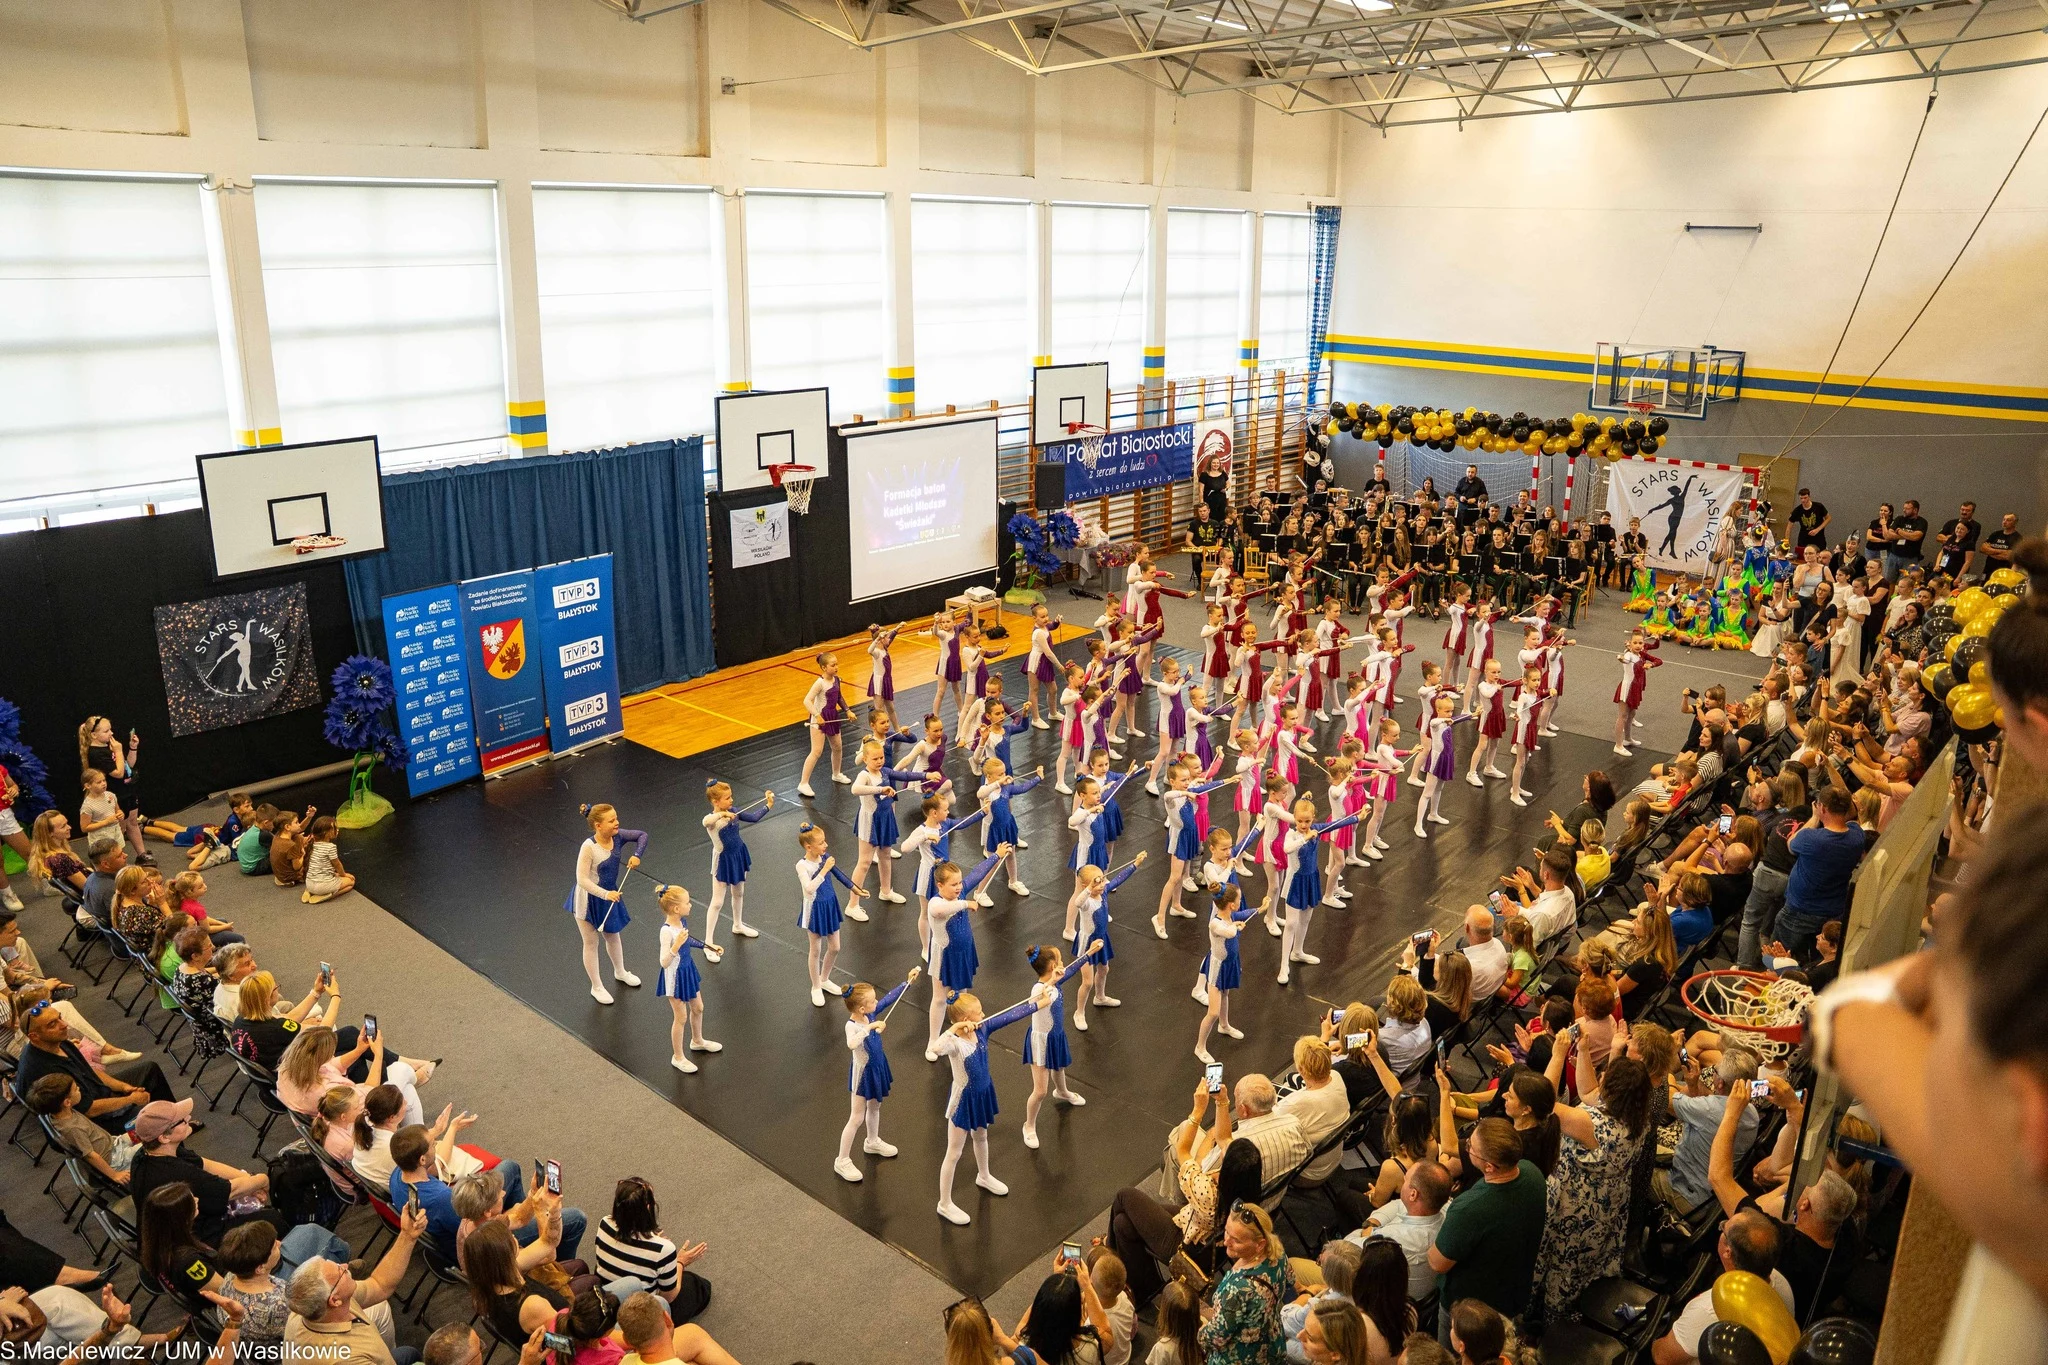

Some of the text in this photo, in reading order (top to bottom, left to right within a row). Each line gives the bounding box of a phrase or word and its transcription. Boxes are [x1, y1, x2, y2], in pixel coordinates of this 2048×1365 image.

[1122, 426, 1190, 455] Białostocki
[1089, 458, 1146, 479] z sercem do ludzi
[884, 483, 945, 502] Formacja baton
[1632, 470, 1678, 497] STARS
[884, 506, 913, 518] Kadetki
[1684, 482, 1720, 563] WASILKÓW
[468, 590, 488, 599] Zadanie
[558, 604, 598, 620] BIAŁYSTOK
[194, 620, 238, 654] STARS
[259, 622, 287, 690] WASILKÓW
[564, 662, 602, 679] BIAŁYSTOK
[569, 718, 606, 736] BIAŁYSTOK
